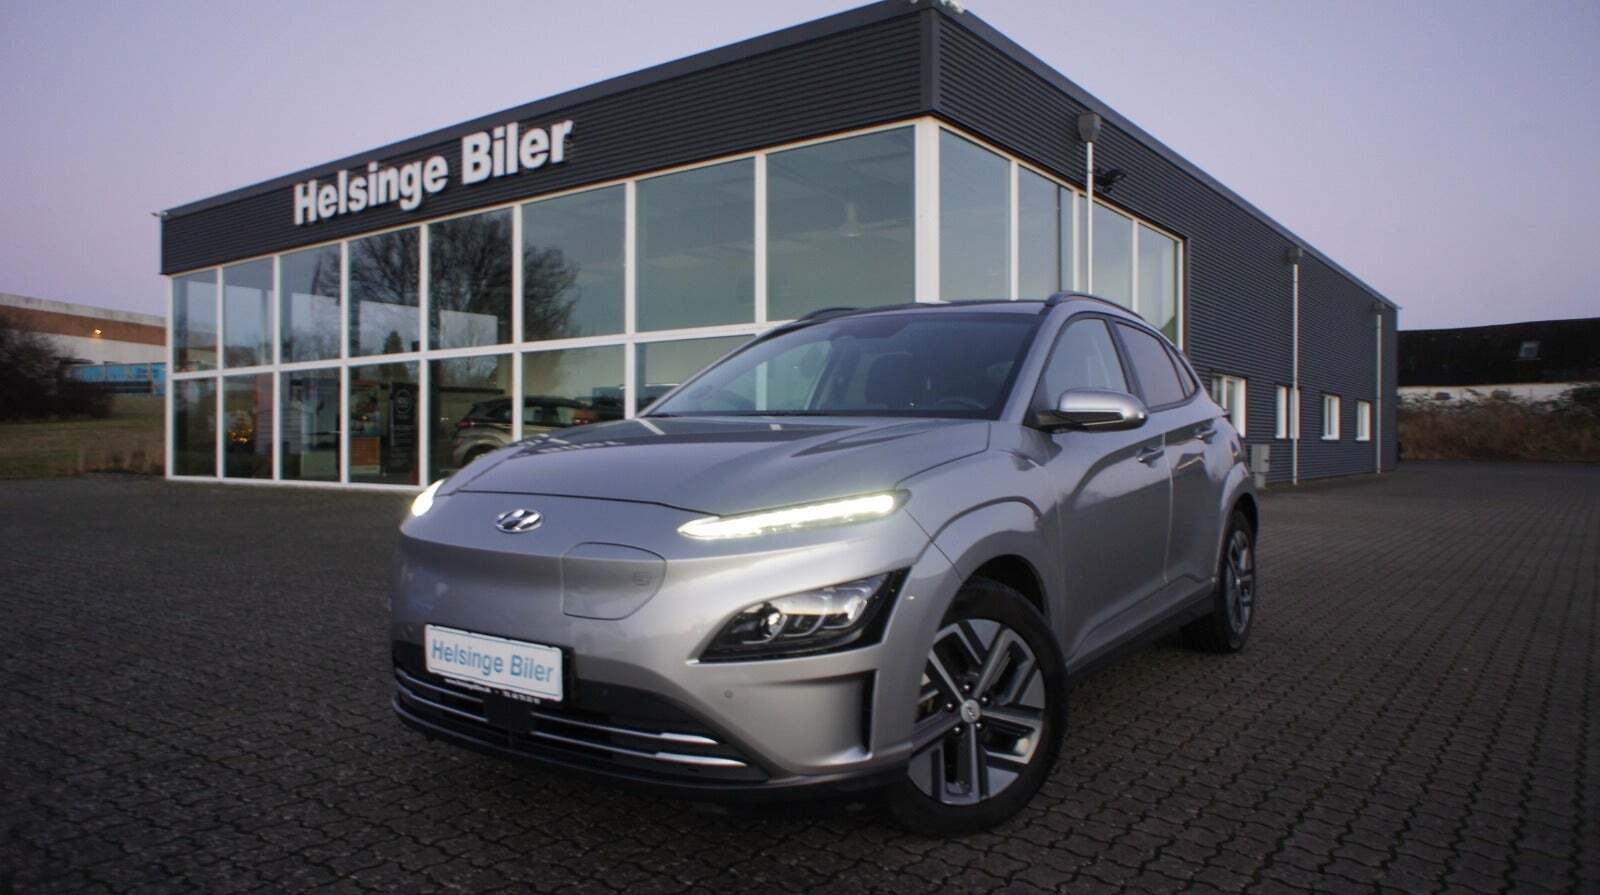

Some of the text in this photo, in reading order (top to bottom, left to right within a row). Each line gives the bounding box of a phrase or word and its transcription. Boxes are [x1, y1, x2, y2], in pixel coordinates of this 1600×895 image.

[294, 120, 574, 225] Helsinge Biler
[431, 639, 554, 682] Helsinge Biler
